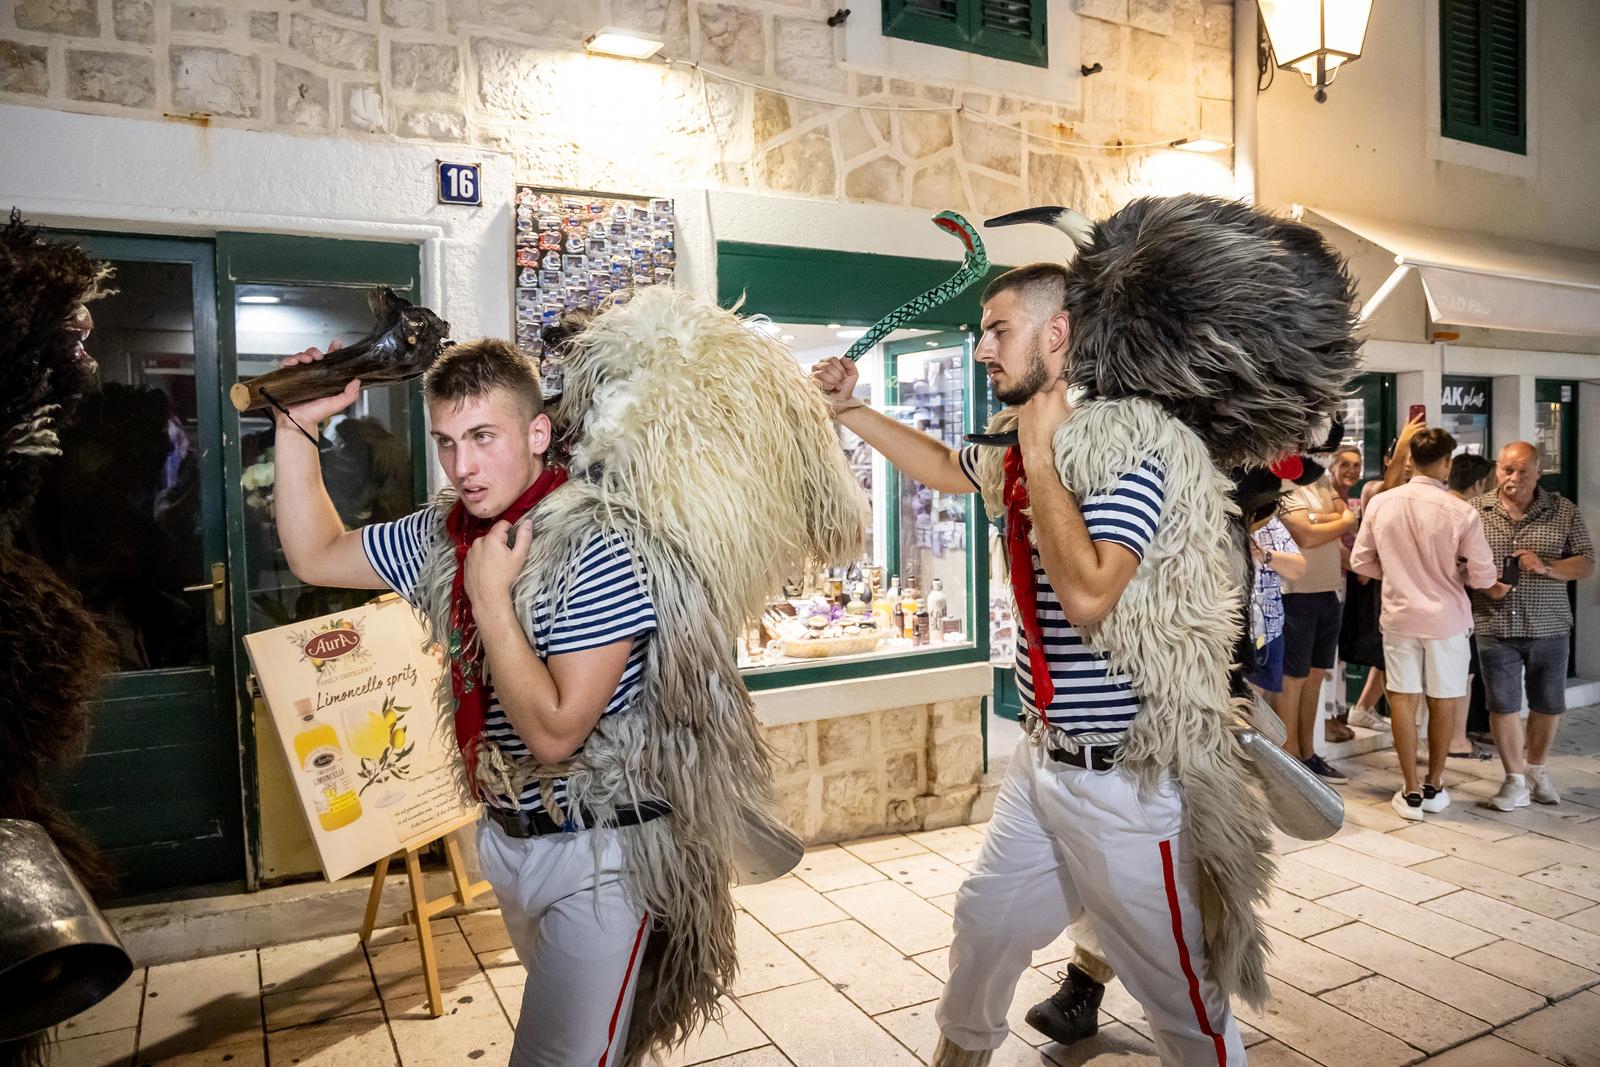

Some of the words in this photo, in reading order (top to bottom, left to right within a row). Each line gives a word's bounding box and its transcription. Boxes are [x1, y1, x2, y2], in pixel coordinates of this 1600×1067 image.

[447, 168, 474, 198] 16
[1441, 386, 1464, 406] AK
[1462, 387, 1485, 411] plus
[316, 676, 384, 711] Limoncello
[387, 664, 417, 691] spritz
